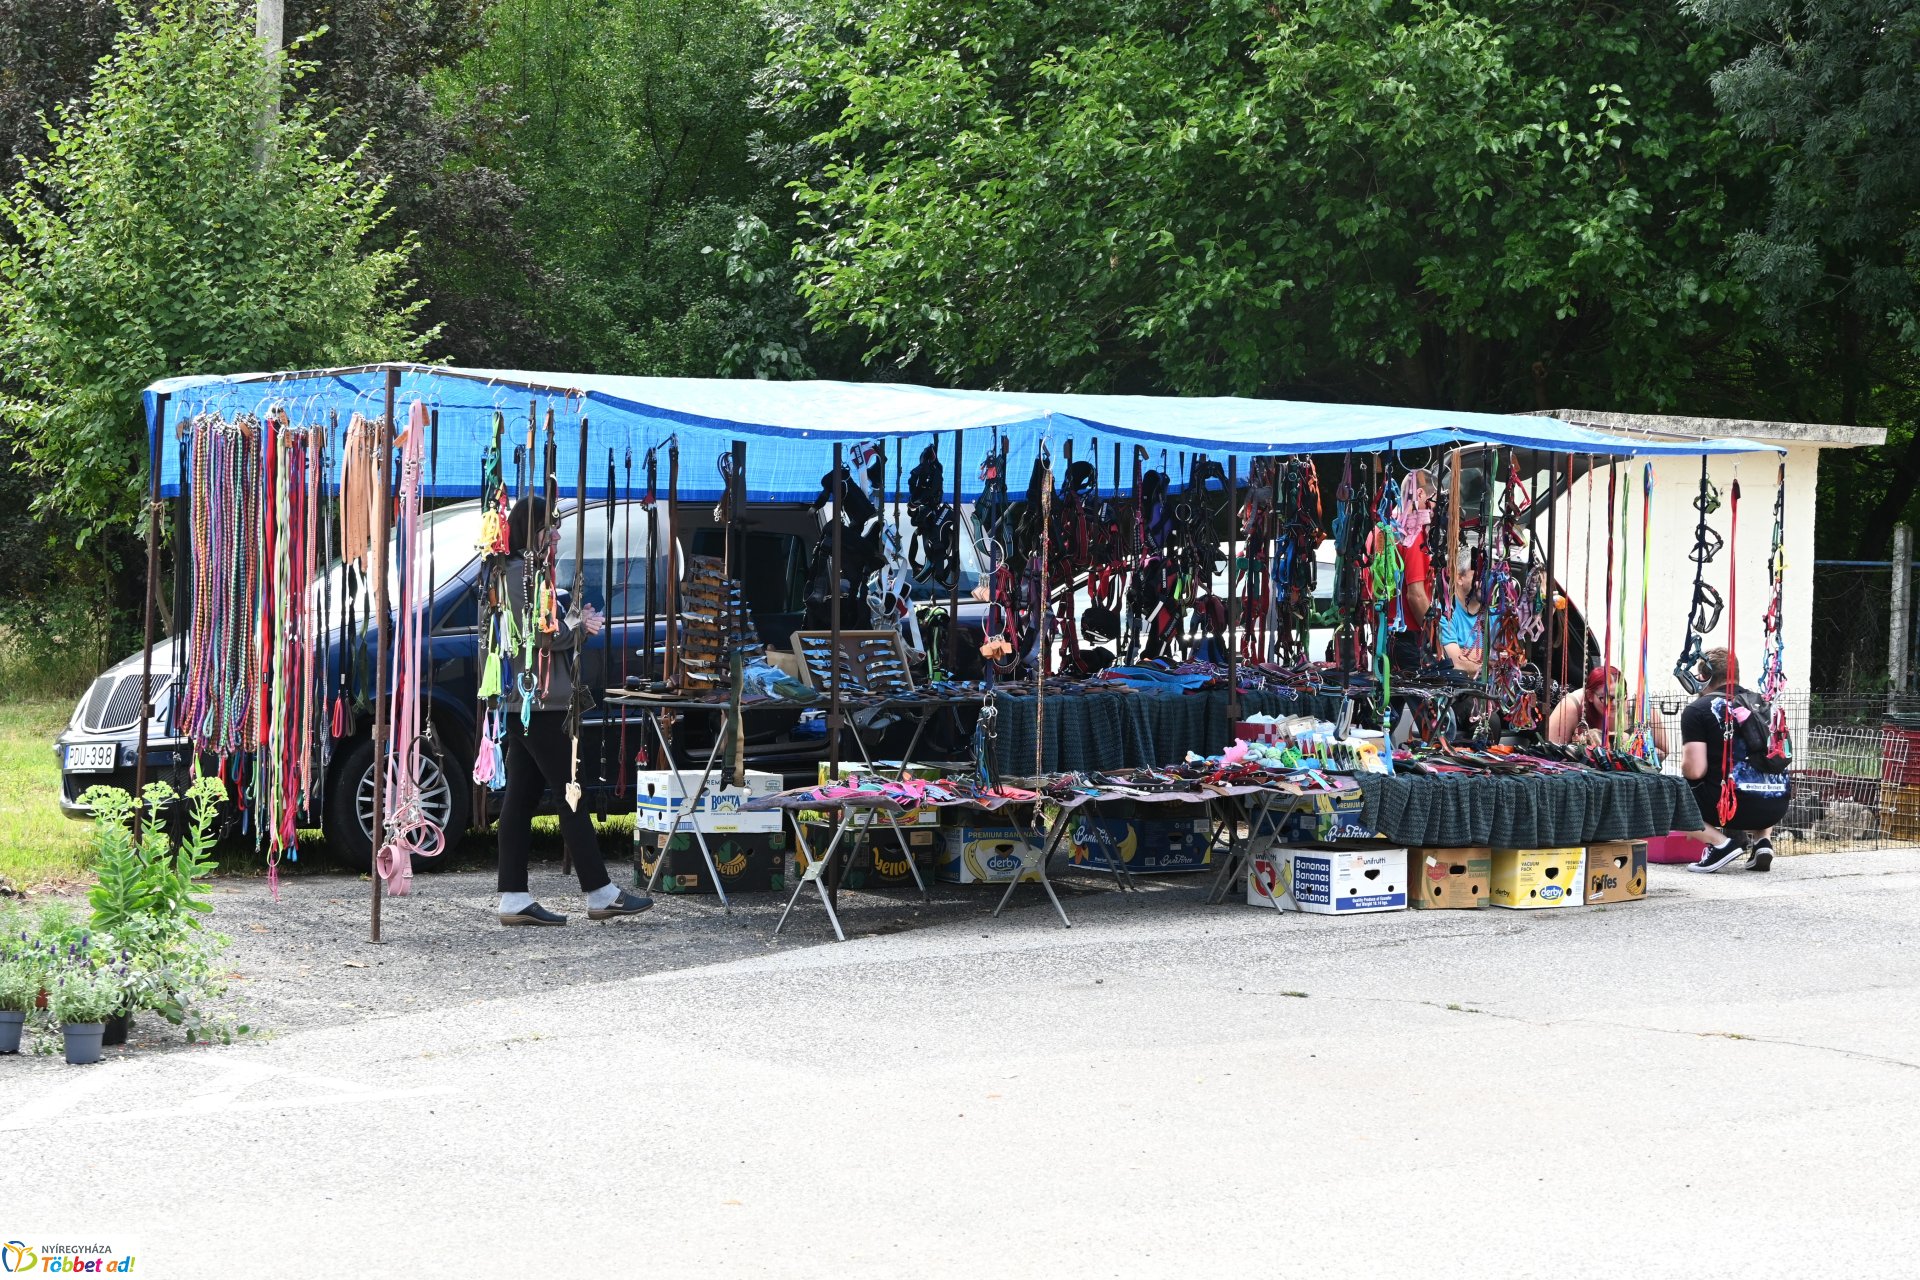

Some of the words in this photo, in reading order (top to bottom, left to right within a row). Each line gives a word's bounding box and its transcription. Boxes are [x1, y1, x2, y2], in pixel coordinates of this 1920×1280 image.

[69, 746, 112, 766] PDU-398
[711, 794, 741, 811] BONITA
[1337, 801, 1360, 809] PREMIUM
[989, 855, 1019, 870] derby
[1296, 860, 1329, 872] Bananas
[1363, 857, 1386, 865] unifrutti
[1296, 870, 1329, 882] Bananas
[1296, 891, 1329, 903] Bananas
[1495, 888, 1511, 897] derby
[1541, 886, 1563, 899] derby
